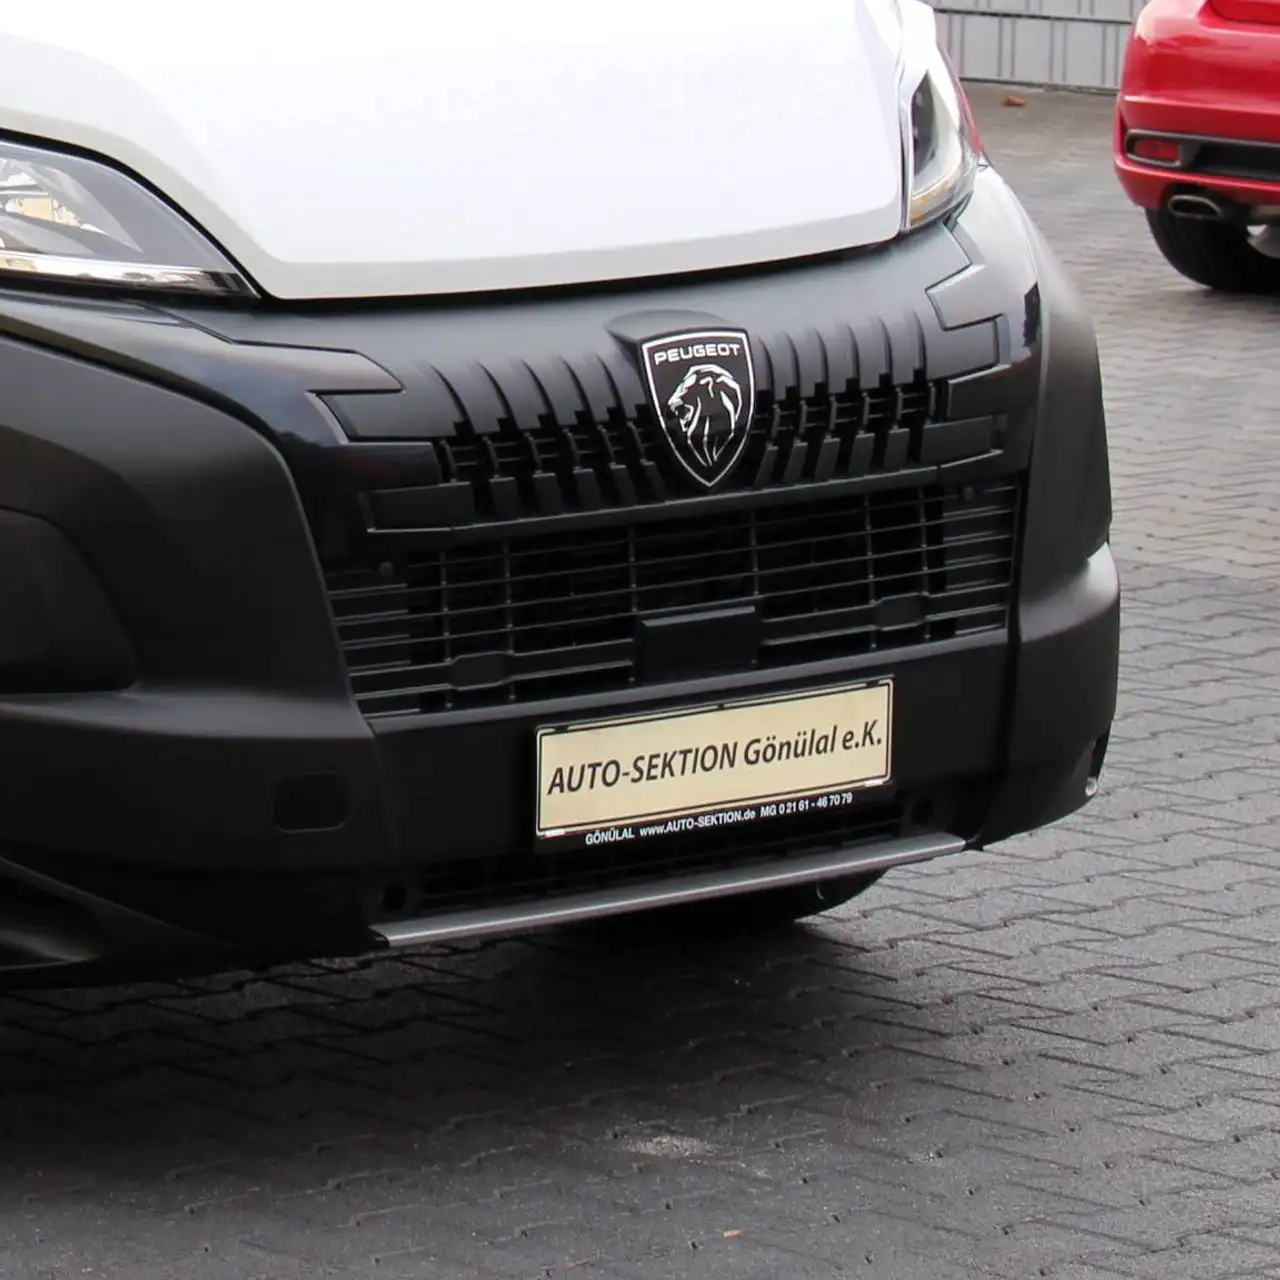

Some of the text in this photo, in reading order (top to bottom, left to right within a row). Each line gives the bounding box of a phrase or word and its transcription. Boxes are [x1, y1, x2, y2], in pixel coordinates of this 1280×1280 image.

[654, 343, 740, 365] PEUGEOT
[547, 719, 882, 795] AUTO-SEKTION Gönülal e.K.
[585, 826, 635, 845] GÖNÜLAL
[639, 808, 756, 837] www.AUTO-SEKTION.de
[760, 804, 777, 818] MG
